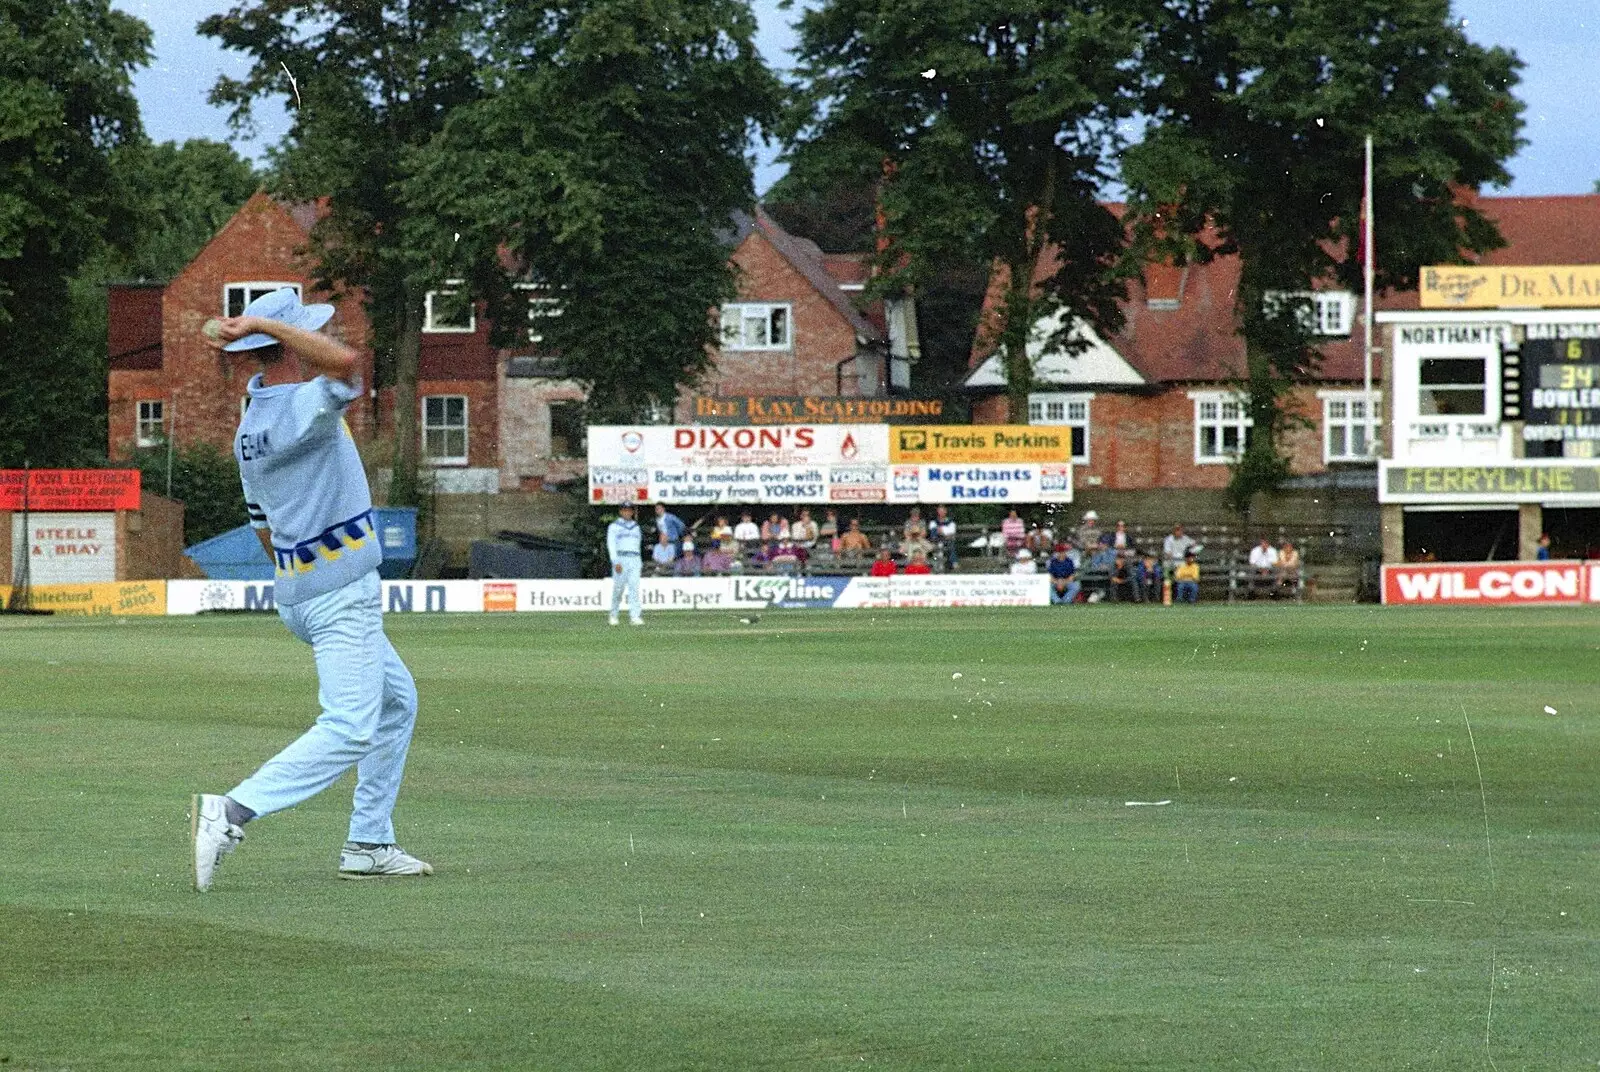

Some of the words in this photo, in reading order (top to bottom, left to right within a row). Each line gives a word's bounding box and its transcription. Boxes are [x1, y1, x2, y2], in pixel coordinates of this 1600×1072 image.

[1401, 327, 1504, 345] NORTHANTS
[1567, 341, 1583, 359] 6
[1560, 365, 1593, 387] 34
[804, 397, 942, 417] SCAFFOLDING
[674, 427, 815, 449] DIXON'S
[932, 432, 985, 448] Travis
[994, 432, 1060, 449] Perkins
[655, 471, 688, 483] Bowl
[693, 473, 702, 483] a
[707, 470, 755, 483] maiden
[759, 473, 790, 483] over
[794, 470, 823, 482] with
[928, 468, 1032, 482] Northants
[1405, 467, 1576, 492] FERRYLINE
[659, 488, 668, 498] a
[672, 485, 722, 500] holiday
[727, 485, 759, 498] from
[764, 484, 824, 498] YORKS!
[951, 485, 1009, 498] Radio
[35, 528, 97, 540] STEELE
[55, 543, 103, 555] BRAY
[733, 577, 836, 604] Keyline
[1396, 570, 1578, 600] WILCON
[530, 590, 602, 607] Howard
[671, 588, 723, 611] Paper
